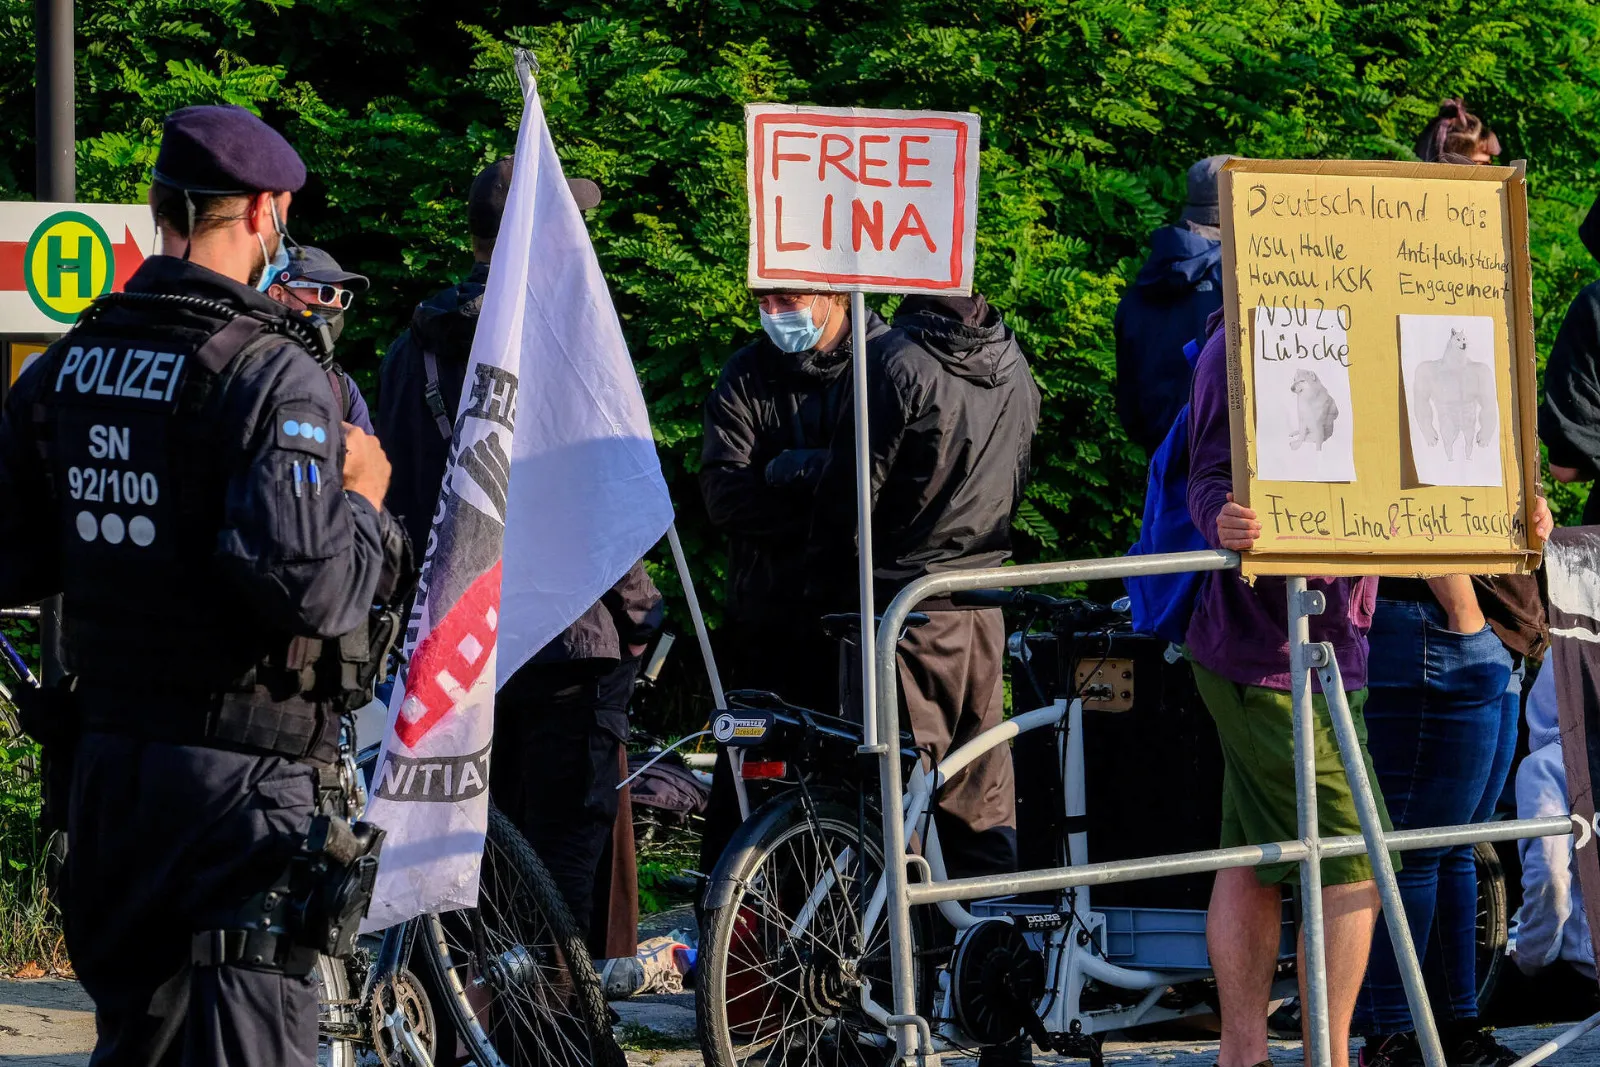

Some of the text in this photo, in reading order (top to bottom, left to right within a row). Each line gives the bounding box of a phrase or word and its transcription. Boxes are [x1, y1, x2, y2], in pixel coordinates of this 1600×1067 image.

[772, 130, 932, 187] FREE
[775, 193, 937, 253] LINA
[1247, 181, 1487, 229] Deutschland bei:
[47, 236, 92, 298] H
[1248, 233, 1347, 264] NSU, Halle
[1332, 265, 1373, 292] KSK
[1399, 271, 1510, 305] Engagement
[1257, 293, 1352, 331] NSU 2.0
[1262, 329, 1353, 367] Lübcke
[55, 345, 186, 401] POLIZEI
[88, 424, 130, 461] SN
[68, 466, 159, 506] 92/100
[1265, 494, 1331, 536] Free
[1341, 497, 1390, 540] Lina
[1400, 497, 1453, 542] Fight
